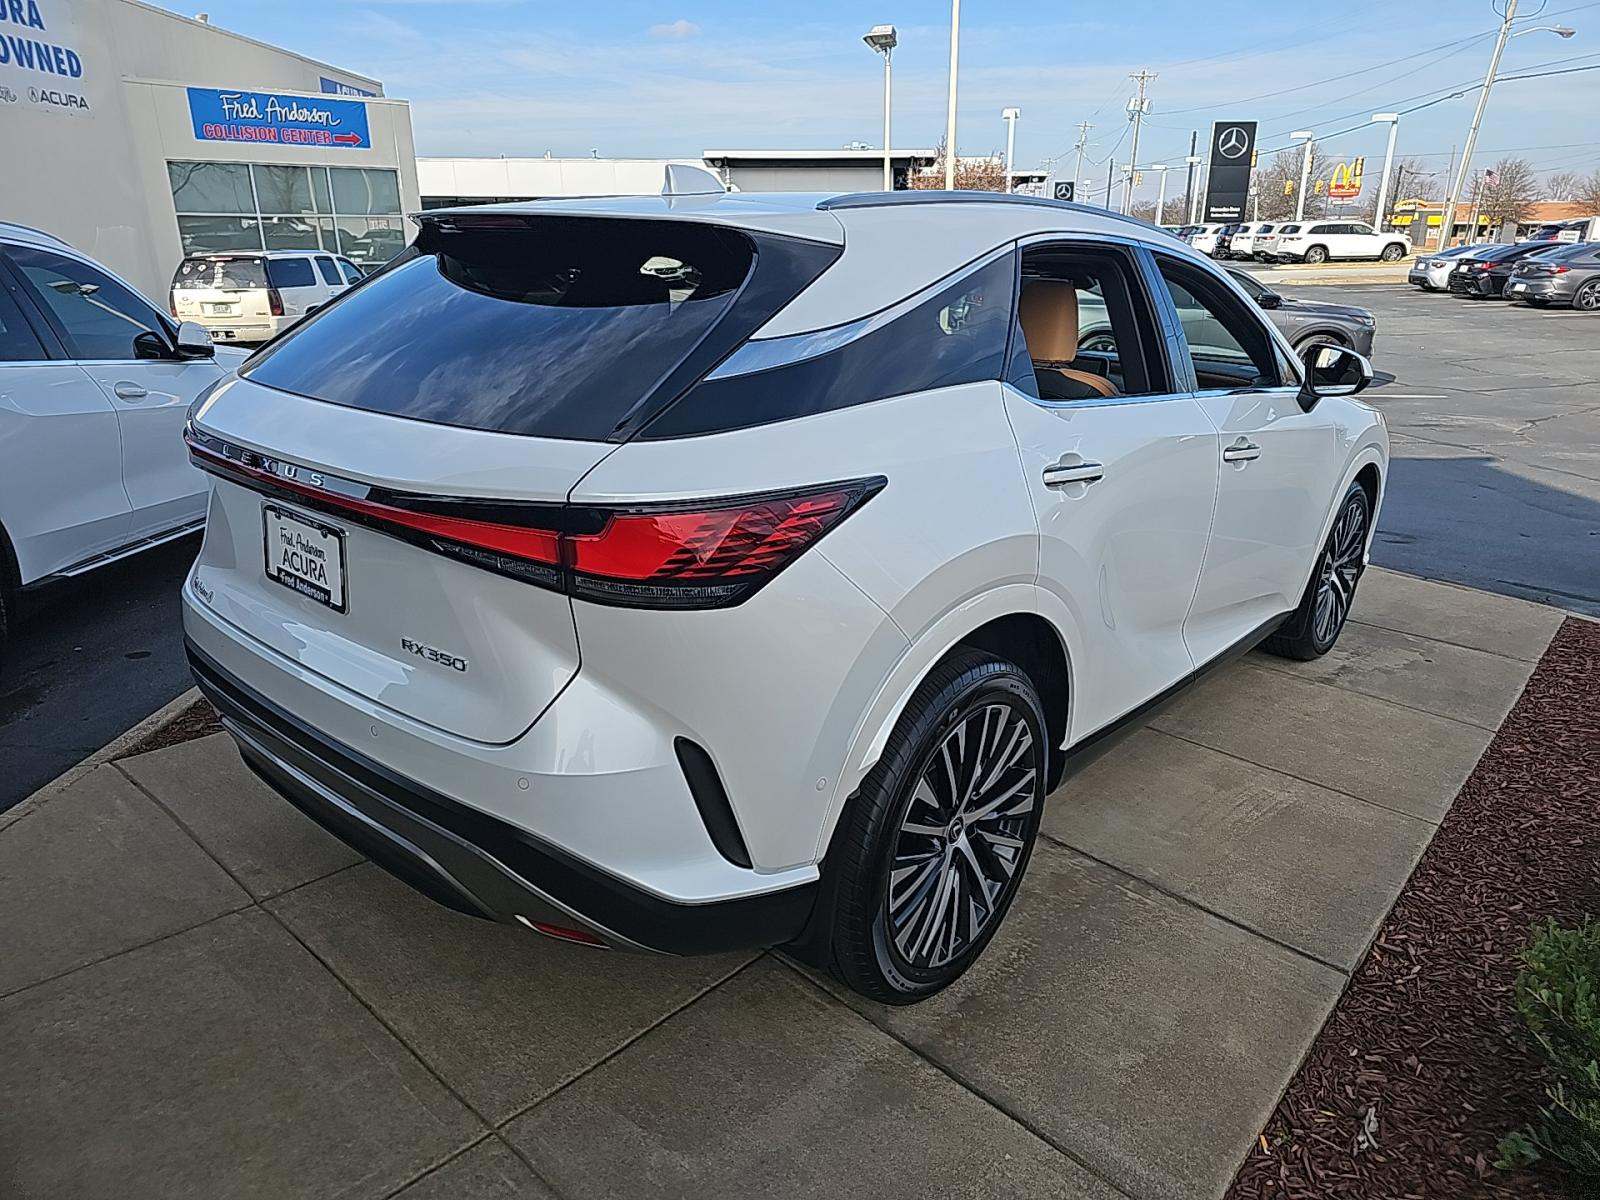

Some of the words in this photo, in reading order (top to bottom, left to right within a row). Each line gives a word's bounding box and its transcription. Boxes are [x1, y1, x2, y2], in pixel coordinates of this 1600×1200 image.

[40, 89, 90, 110] ACURA
[220, 94, 263, 121] Fred
[265, 97, 342, 127] Anderson
[204, 124, 278, 142] COLLISION
[281, 128, 332, 144] CENTER
[222, 444, 326, 487] LEXUS
[280, 527, 296, 549] Fred
[296, 533, 327, 562] Anderson
[280, 571, 295, 588] Fred
[282, 548, 329, 586] ACURA
